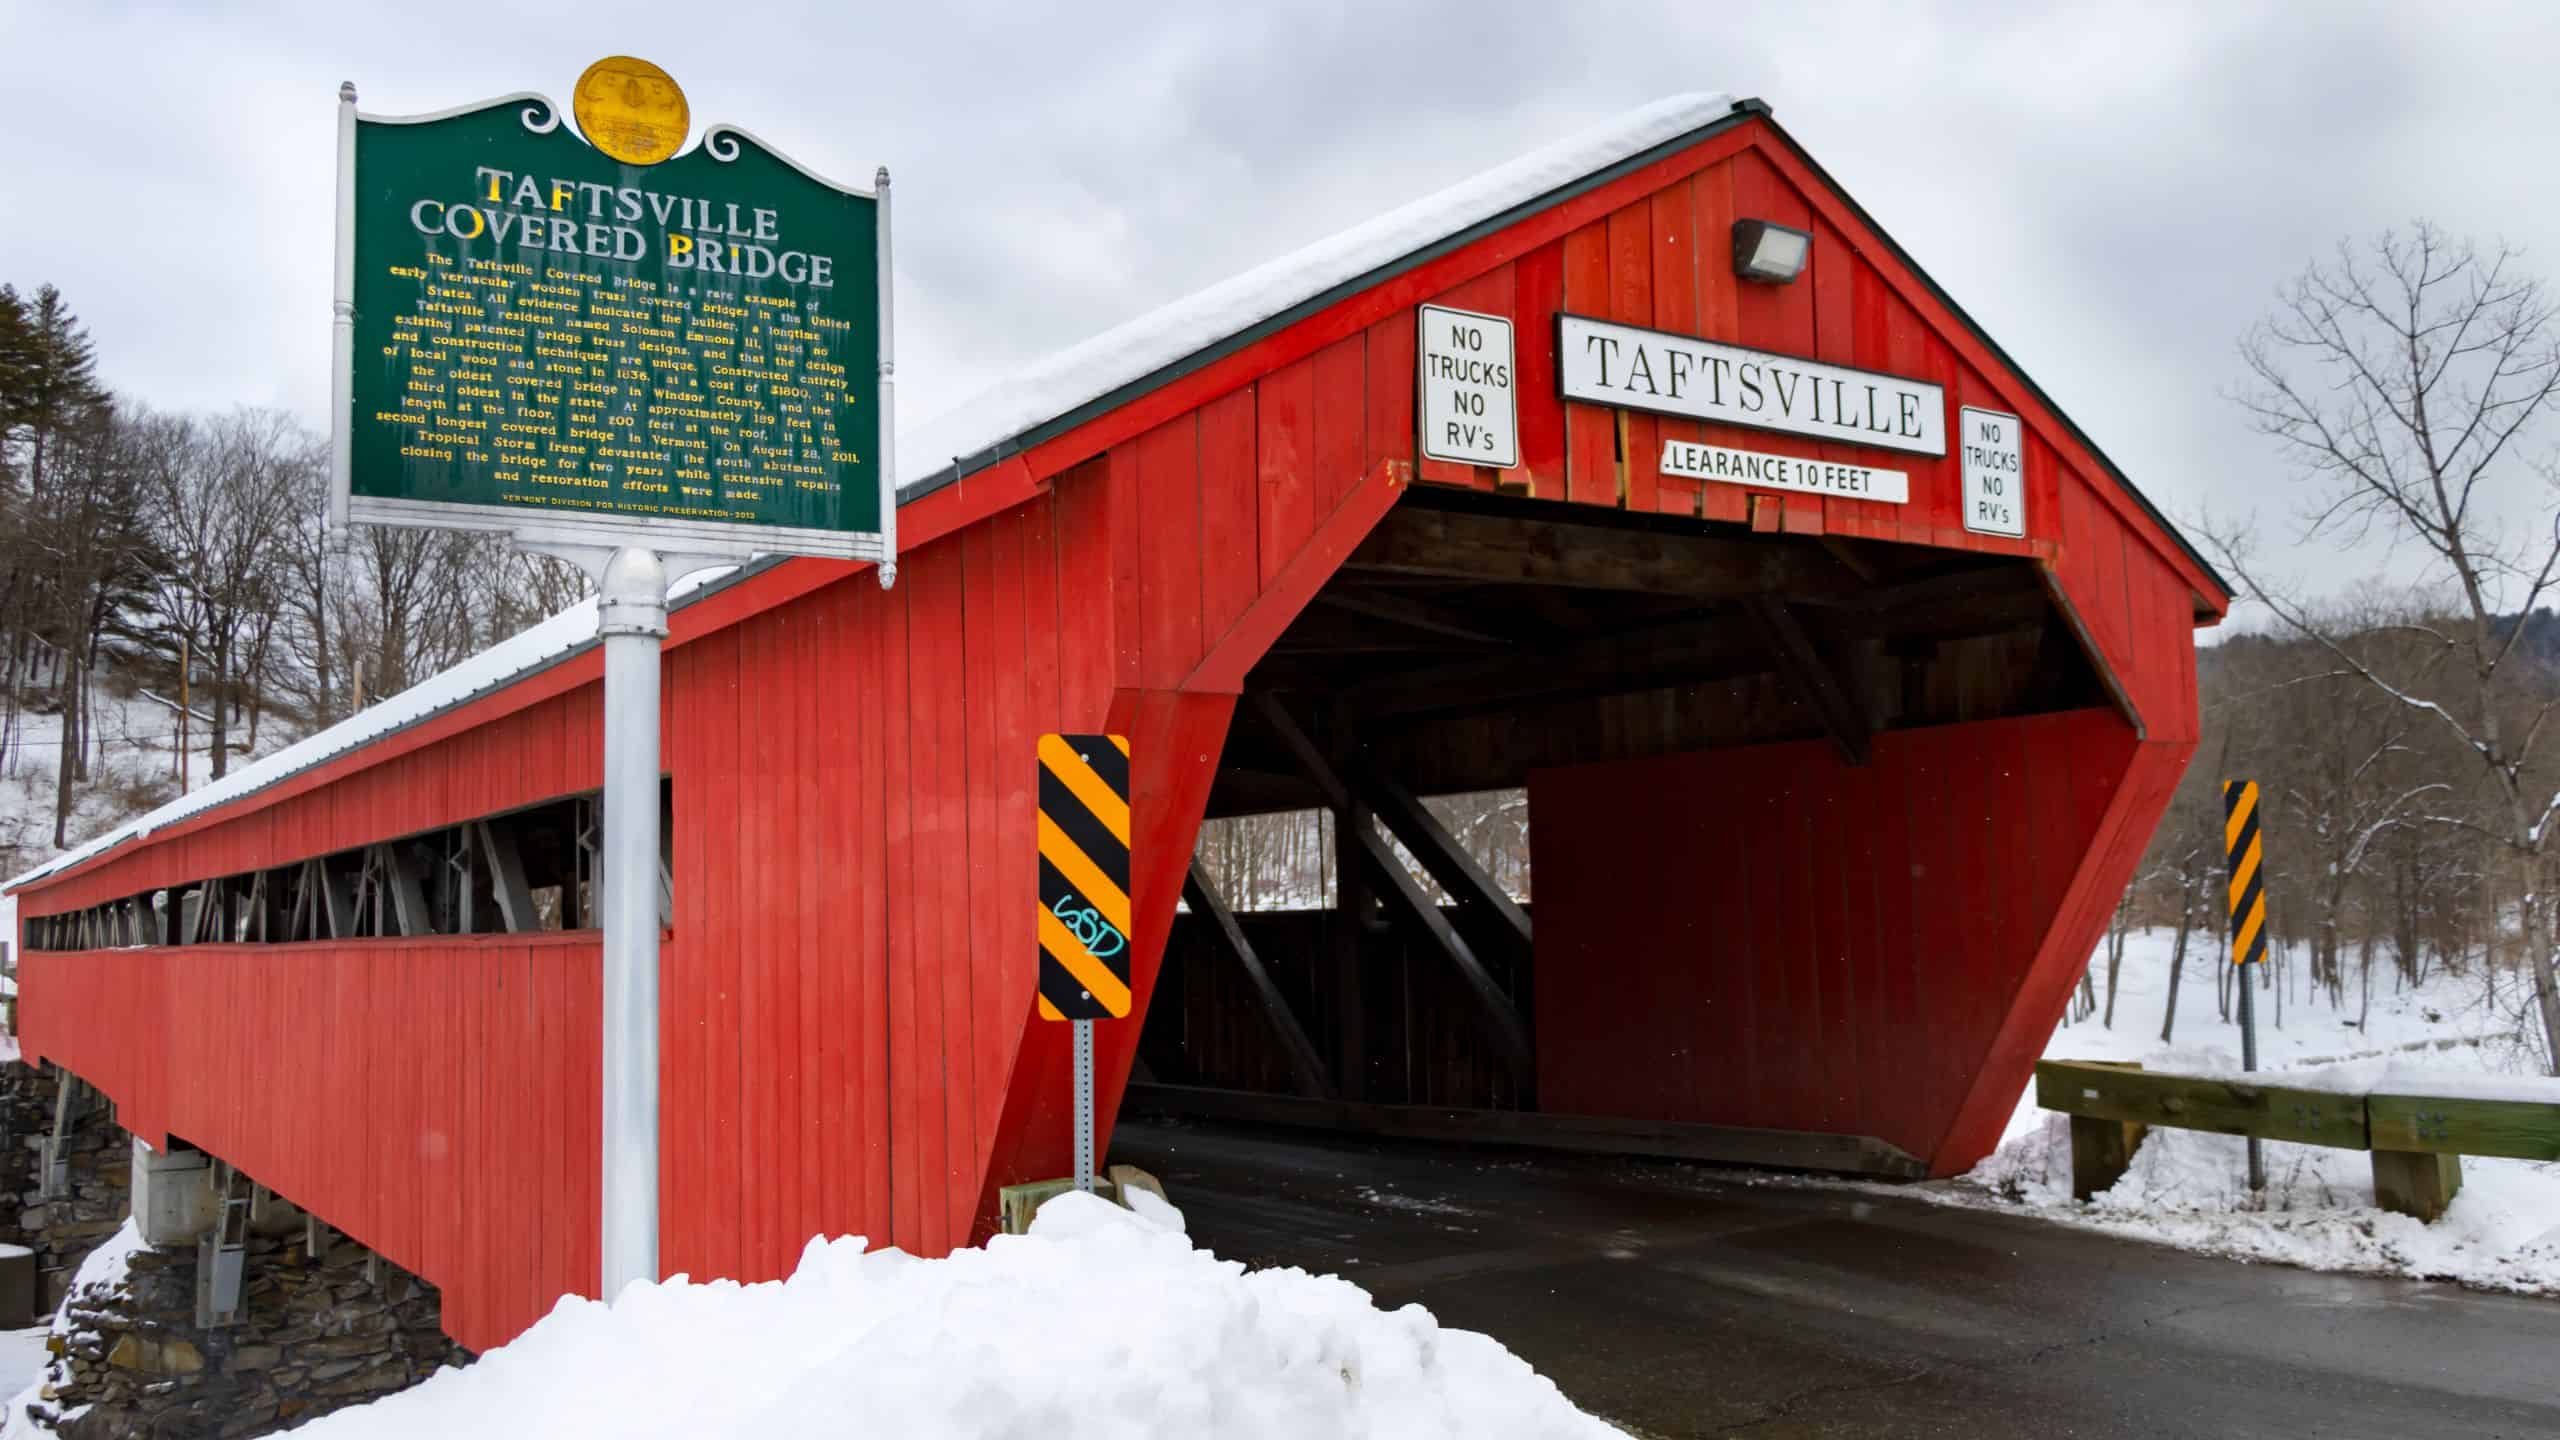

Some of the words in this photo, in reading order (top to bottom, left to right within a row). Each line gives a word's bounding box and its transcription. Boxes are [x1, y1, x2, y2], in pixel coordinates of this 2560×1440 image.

[476, 165, 779, 240] TAFTSVILLE
[410, 199, 647, 262] COVERED
[666, 232, 834, 288] BRIDGE
[388, 265, 428, 280] early
[439, 271, 516, 288] vernacular
[529, 282, 580, 296] wooden
[592, 289, 626, 302] truss
[639, 296, 691, 310] covered
[701, 302, 749, 317] bridges
[759, 309, 770, 319] in
[780, 313, 800, 323] the
[810, 315, 850, 329] United
[425, 252, 453, 265] The
[467, 257, 533, 275] Taftsville
[545, 267, 601, 284] Covered
[613, 276, 656, 291] Bridge
[667, 282, 679, 293] is
[688, 287, 696, 295] a
[743, 295, 796, 309] example
[805, 301, 819, 311] of
[415, 299, 485, 316] Taftsville
[498, 311, 554, 324] resident
[565, 319, 609, 331] named
[621, 323, 675, 338] Solomon
[685, 330, 734, 344] Emmons
[774, 343, 803, 353] used
[812, 346, 828, 356] no
[487, 292, 506, 304] All
[517, 295, 578, 311] evidence
[591, 304, 649, 320] indicates
[660, 312, 681, 324] the
[751, 325, 759, 333] a
[768, 325, 820, 340] longtime
[1452, 325, 1482, 351] NO
[391, 331, 418, 342] and
[431, 336, 522, 352] construction
[535, 345, 608, 362] techniques
[619, 355, 642, 365] are
[712, 364, 788, 381] Constructed
[799, 376, 848, 389] entirely
[394, 315, 452, 331] existing
[464, 323, 525, 337] patented
[536, 329, 581, 344] bridge
[591, 335, 626, 347] truss
[703, 349, 726, 359] and
[738, 352, 764, 363] that
[773, 356, 794, 367] the
[805, 360, 844, 374] design
[382, 345, 399, 356] of
[410, 347, 446, 360] local
[460, 353, 497, 365] wood
[508, 359, 534, 369] and
[544, 362, 584, 374] stone
[591, 366, 605, 376] in
[666, 375, 678, 384] at
[688, 378, 697, 387] a
[707, 380, 734, 390] cost
[744, 383, 758, 392] of
[843, 393, 855, 403] is
[411, 364, 434, 376] the
[448, 369, 492, 381] oldest
[505, 375, 562, 388] covered
[573, 380, 618, 395] bridge
[628, 385, 641, 396] in
[653, 388, 704, 402] Windsor
[780, 403, 802, 413] and
[811, 405, 831, 415] the
[1428, 353, 1508, 388] TRUCKS
[1587, 335, 1923, 438] TAFTSVILLE
[401, 396, 446, 410] length
[457, 401, 472, 411] at
[482, 404, 504, 414] the
[570, 412, 596, 423] and
[647, 418, 674, 430] feet
[685, 423, 697, 432] at
[709, 425, 729, 435] the
[801, 433, 812, 443] is
[820, 436, 840, 446] the
[407, 380, 444, 392] third
[456, 385, 500, 398] oldest
[511, 389, 524, 400] in
[535, 392, 559, 404] the
[623, 401, 637, 411] At
[648, 405, 742, 422] approximately
[786, 416, 811, 428] feet
[823, 421, 835, 431] in
[1454, 390, 1485, 416] NO
[375, 411, 425, 423] second
[436, 415, 487, 430] longest
[500, 423, 556, 435] covered
[569, 427, 614, 442] bridge
[628, 432, 641, 443] in
[723, 441, 740, 452] On
[751, 444, 792, 457] August
[416, 430, 479, 445] Tropical
[492, 436, 536, 450] Storm
[548, 441, 586, 454] Irene
[597, 446, 670, 461] devastated
[683, 453, 704, 464] the
[714, 457, 751, 468] south
[1447, 422, 1494, 450] RV's
[1981, 422, 2001, 443] NO
[399, 445, 452, 461] closing
[465, 450, 488, 461] the
[500, 453, 546, 468] bridge
[557, 458, 578, 469] for
[588, 461, 613, 472] two
[625, 465, 663, 476] years
[674, 468, 711, 480] while
[722, 473, 783, 486] extensive
[795, 479, 840, 490] repairs
[1665, 446, 1788, 483] LEARANCE
[1796, 464, 1819, 486] 10
[1825, 466, 1871, 493] FEET
[1966, 445, 2018, 472] TRUCKS
[493, 471, 519, 480] and
[530, 473, 608, 487] restoration
[622, 480, 668, 492] efforts
[680, 486, 712, 496] were
[550, 497, 592, 508] DIVISION
[595, 500, 612, 509] FOR
[617, 502, 658, 512] HISTORIC
[1983, 475, 2003, 496] NO
[1978, 501, 2009, 524] RV's
